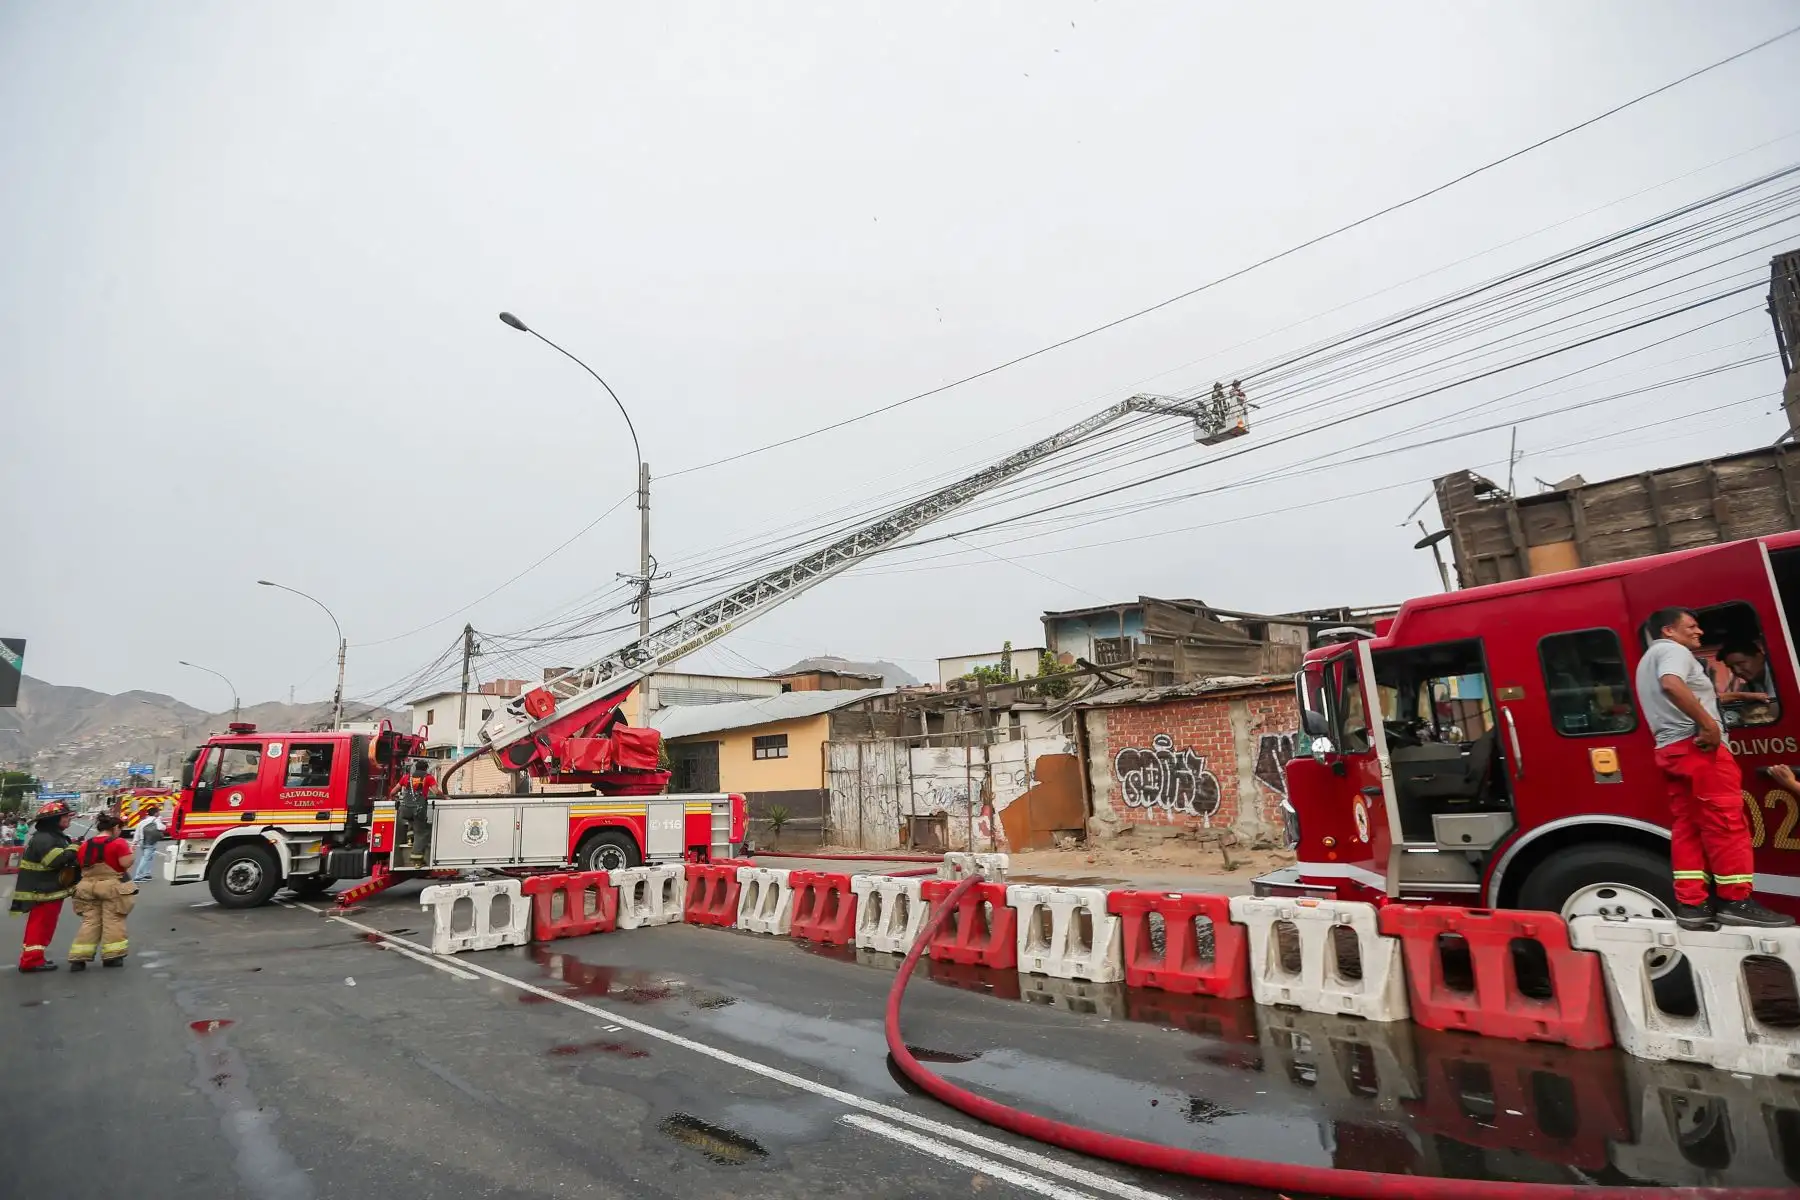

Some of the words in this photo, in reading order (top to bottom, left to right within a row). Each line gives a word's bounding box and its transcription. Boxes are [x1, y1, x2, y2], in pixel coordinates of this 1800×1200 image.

[1729, 736, 1798, 755] OLIVOS
[279, 790, 330, 799] SALVADORA
[662, 819, 683, 830] 116
